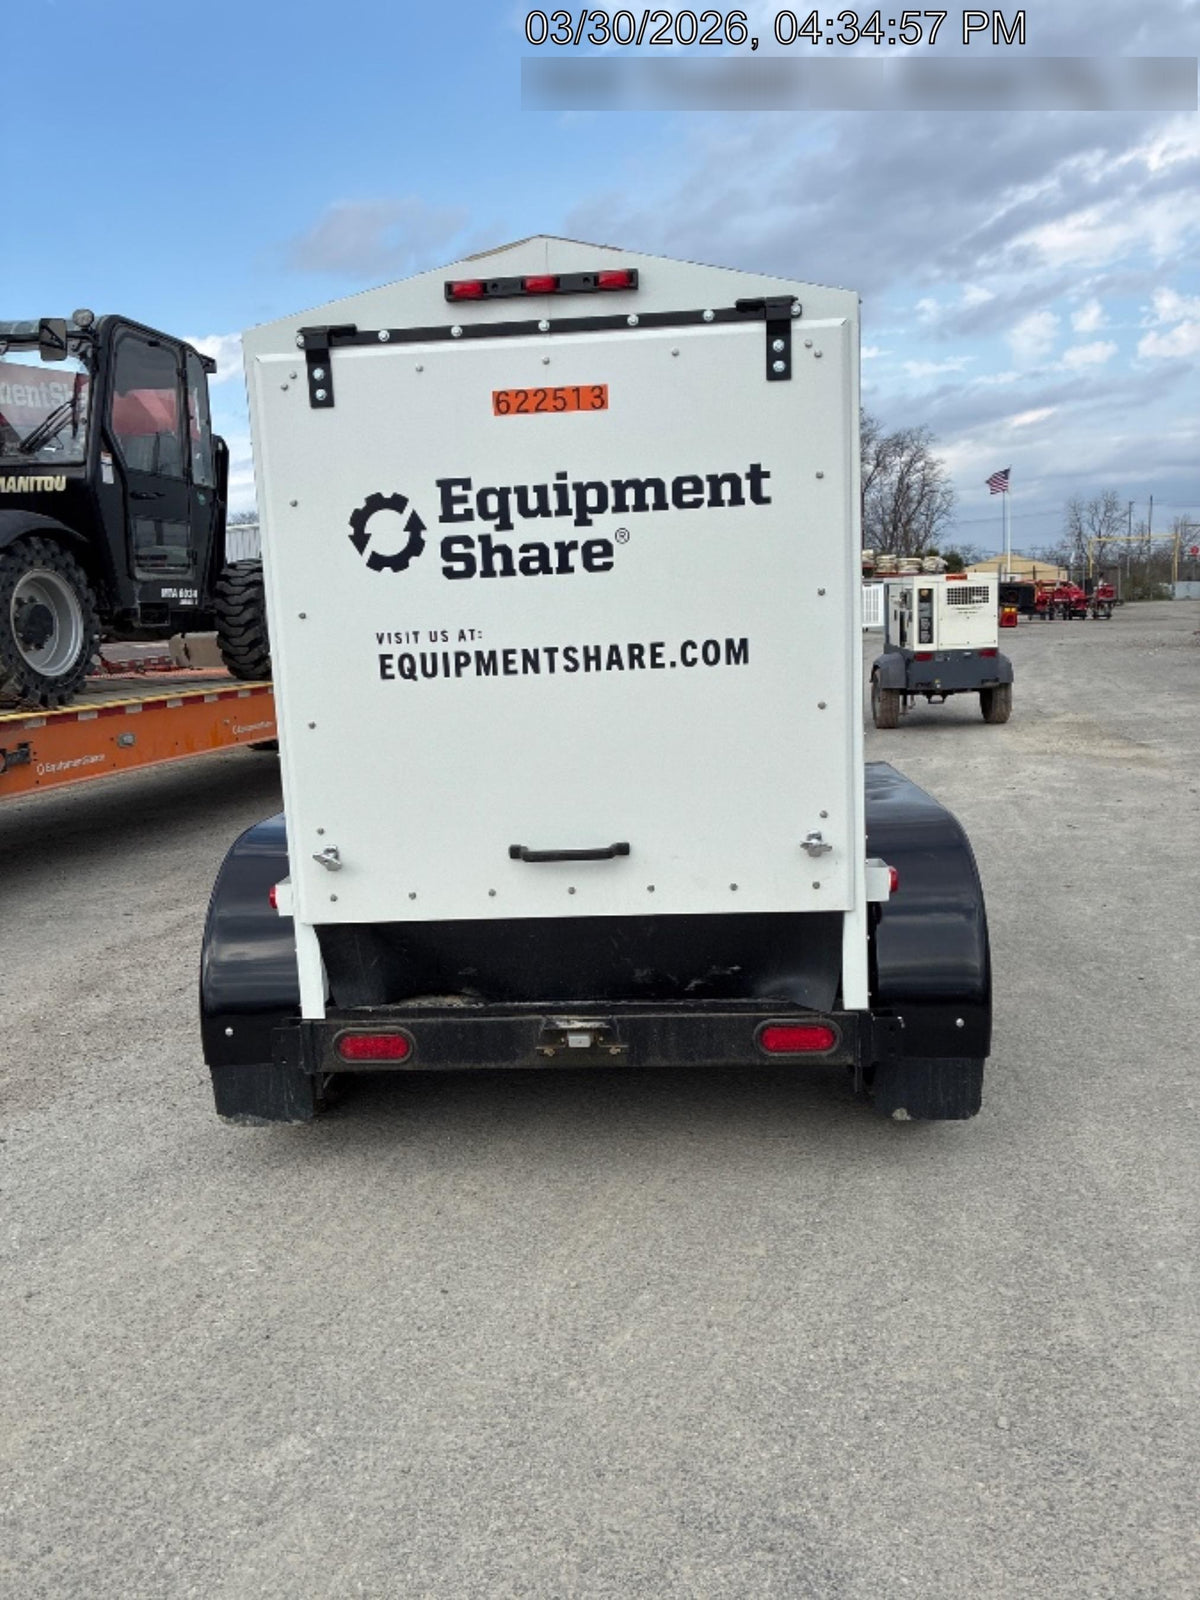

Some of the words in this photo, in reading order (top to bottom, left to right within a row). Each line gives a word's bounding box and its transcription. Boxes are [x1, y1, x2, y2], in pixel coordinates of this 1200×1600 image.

[495, 386, 606, 415] 622513
[435, 463, 772, 531] Equipment
[376, 630, 420, 645] VISIT
[429, 630, 449, 643] US
[457, 628, 483, 642] AT:
[378, 637, 750, 682] EQUIPMENTSHARE.COM
